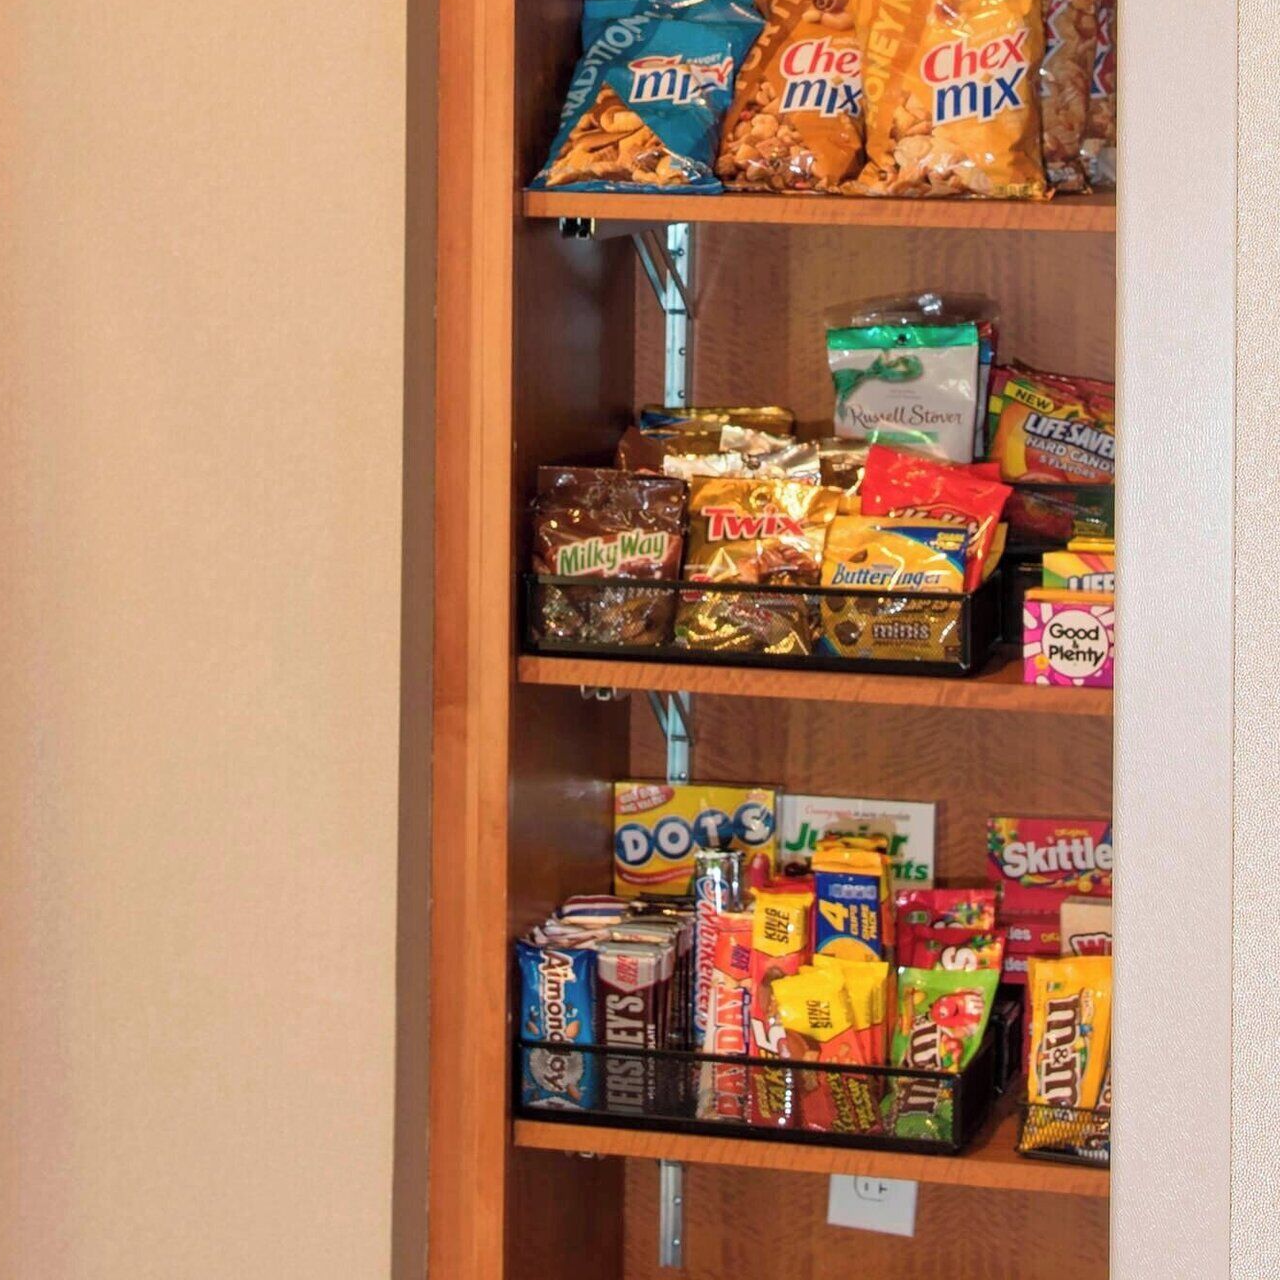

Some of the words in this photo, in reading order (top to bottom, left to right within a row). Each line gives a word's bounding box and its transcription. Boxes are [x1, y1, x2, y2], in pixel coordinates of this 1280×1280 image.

[783, 41, 860, 76] Che
[924, 31, 1025, 83] Chex
[784, 78, 861, 115] mix
[936, 68, 1024, 121] mix
[1015, 389, 1051, 410] NEW
[844, 404, 905, 430] Russell
[909, 404, 963, 426] Stover
[1026, 437, 1067, 457] HARD
[702, 504, 805, 541] Twix
[559, 538, 618, 574] Milky
[620, 530, 667, 560] Way
[1049, 622, 1099, 640] Good
[1048, 644, 1106, 667] Plenty
[617, 802, 774, 864] DOTS
[765, 907, 777, 940] KING
[778, 910, 790, 944] SIZE
[819, 898, 849, 932] 4
[809, 999, 821, 1029] KING
[753, 1017, 787, 1057] 5
